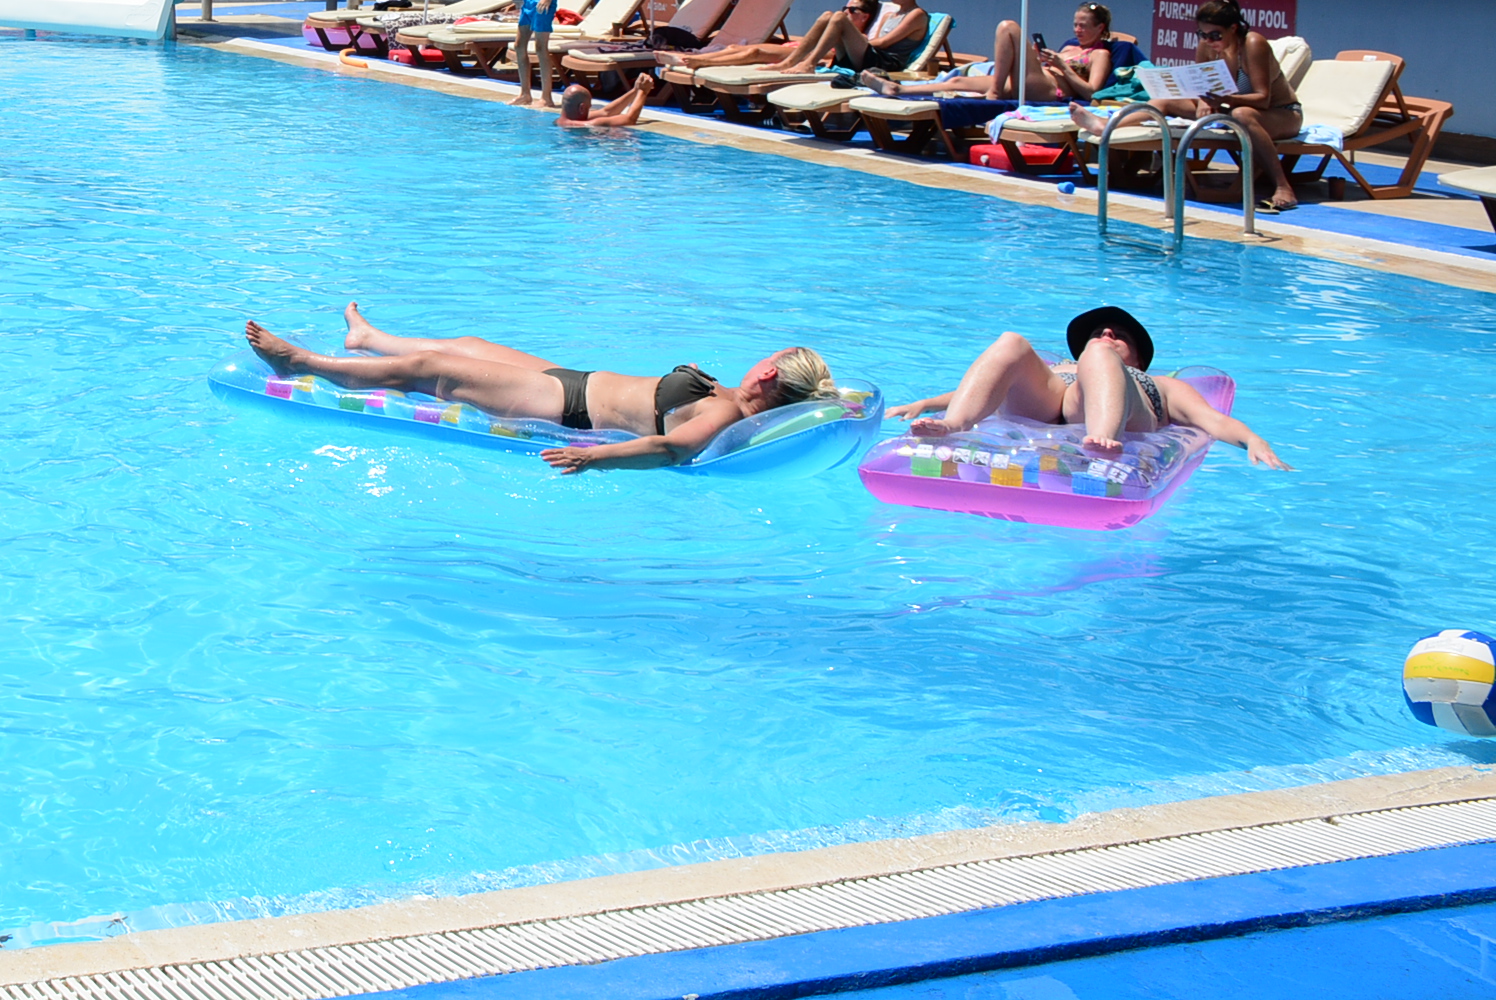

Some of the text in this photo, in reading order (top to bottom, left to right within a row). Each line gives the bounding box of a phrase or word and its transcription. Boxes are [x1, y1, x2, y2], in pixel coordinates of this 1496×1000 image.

[1158, 0, 1200, 20] PURCHA
[1258, 9, 1288, 29] POOL
[1157, 28, 1199, 50] BAR MA
[1155, 56, 1196, 67] ARO
